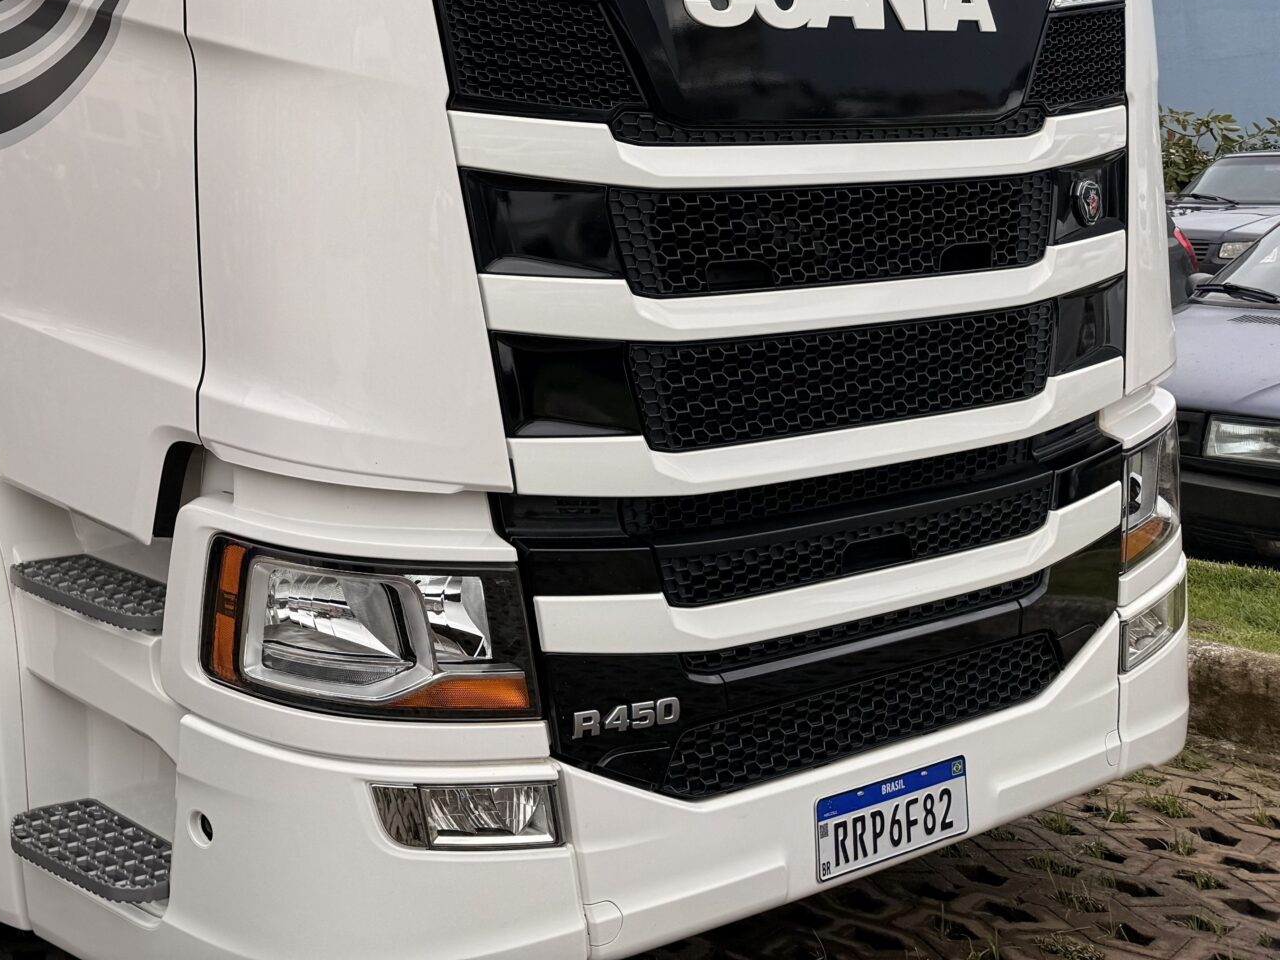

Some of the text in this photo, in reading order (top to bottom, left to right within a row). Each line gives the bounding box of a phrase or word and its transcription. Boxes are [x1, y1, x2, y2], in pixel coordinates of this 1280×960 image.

[881, 779, 906, 795] BRASIL
[833, 787, 954, 867] RRP6F82
[822, 861, 831, 877] BR
